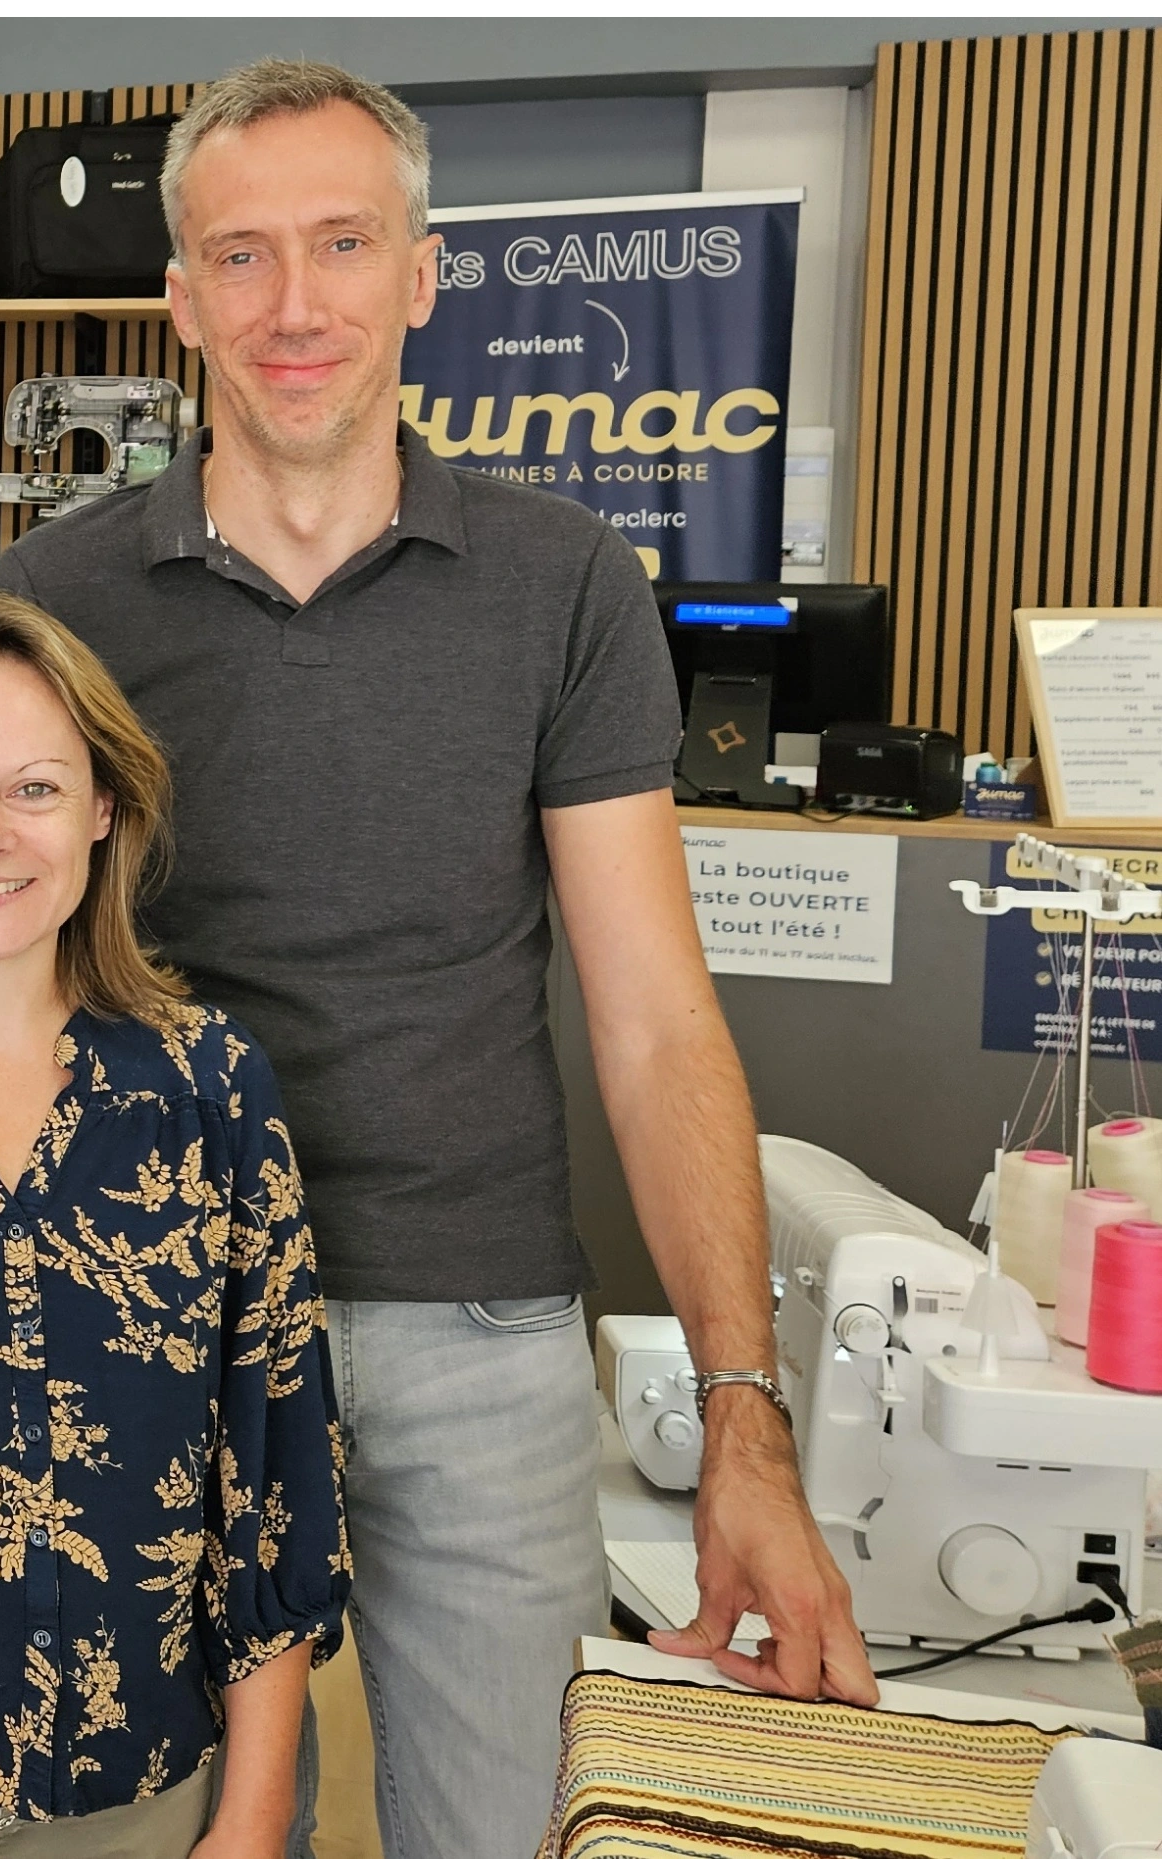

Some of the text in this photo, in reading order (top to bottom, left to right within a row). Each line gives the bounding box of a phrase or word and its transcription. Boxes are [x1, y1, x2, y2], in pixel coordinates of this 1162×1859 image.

[504, 226, 742, 286] CAMUS
[487, 334, 584, 356] devient
[567, 461, 584, 482] À
[593, 463, 709, 482] COUDRE
[700, 860, 850, 884] La boutique
[691, 890, 870, 912] este OUVERTE
[711, 918, 841, 939] tout l'été !
[1063, 945, 1136, 962] VEDEUR
